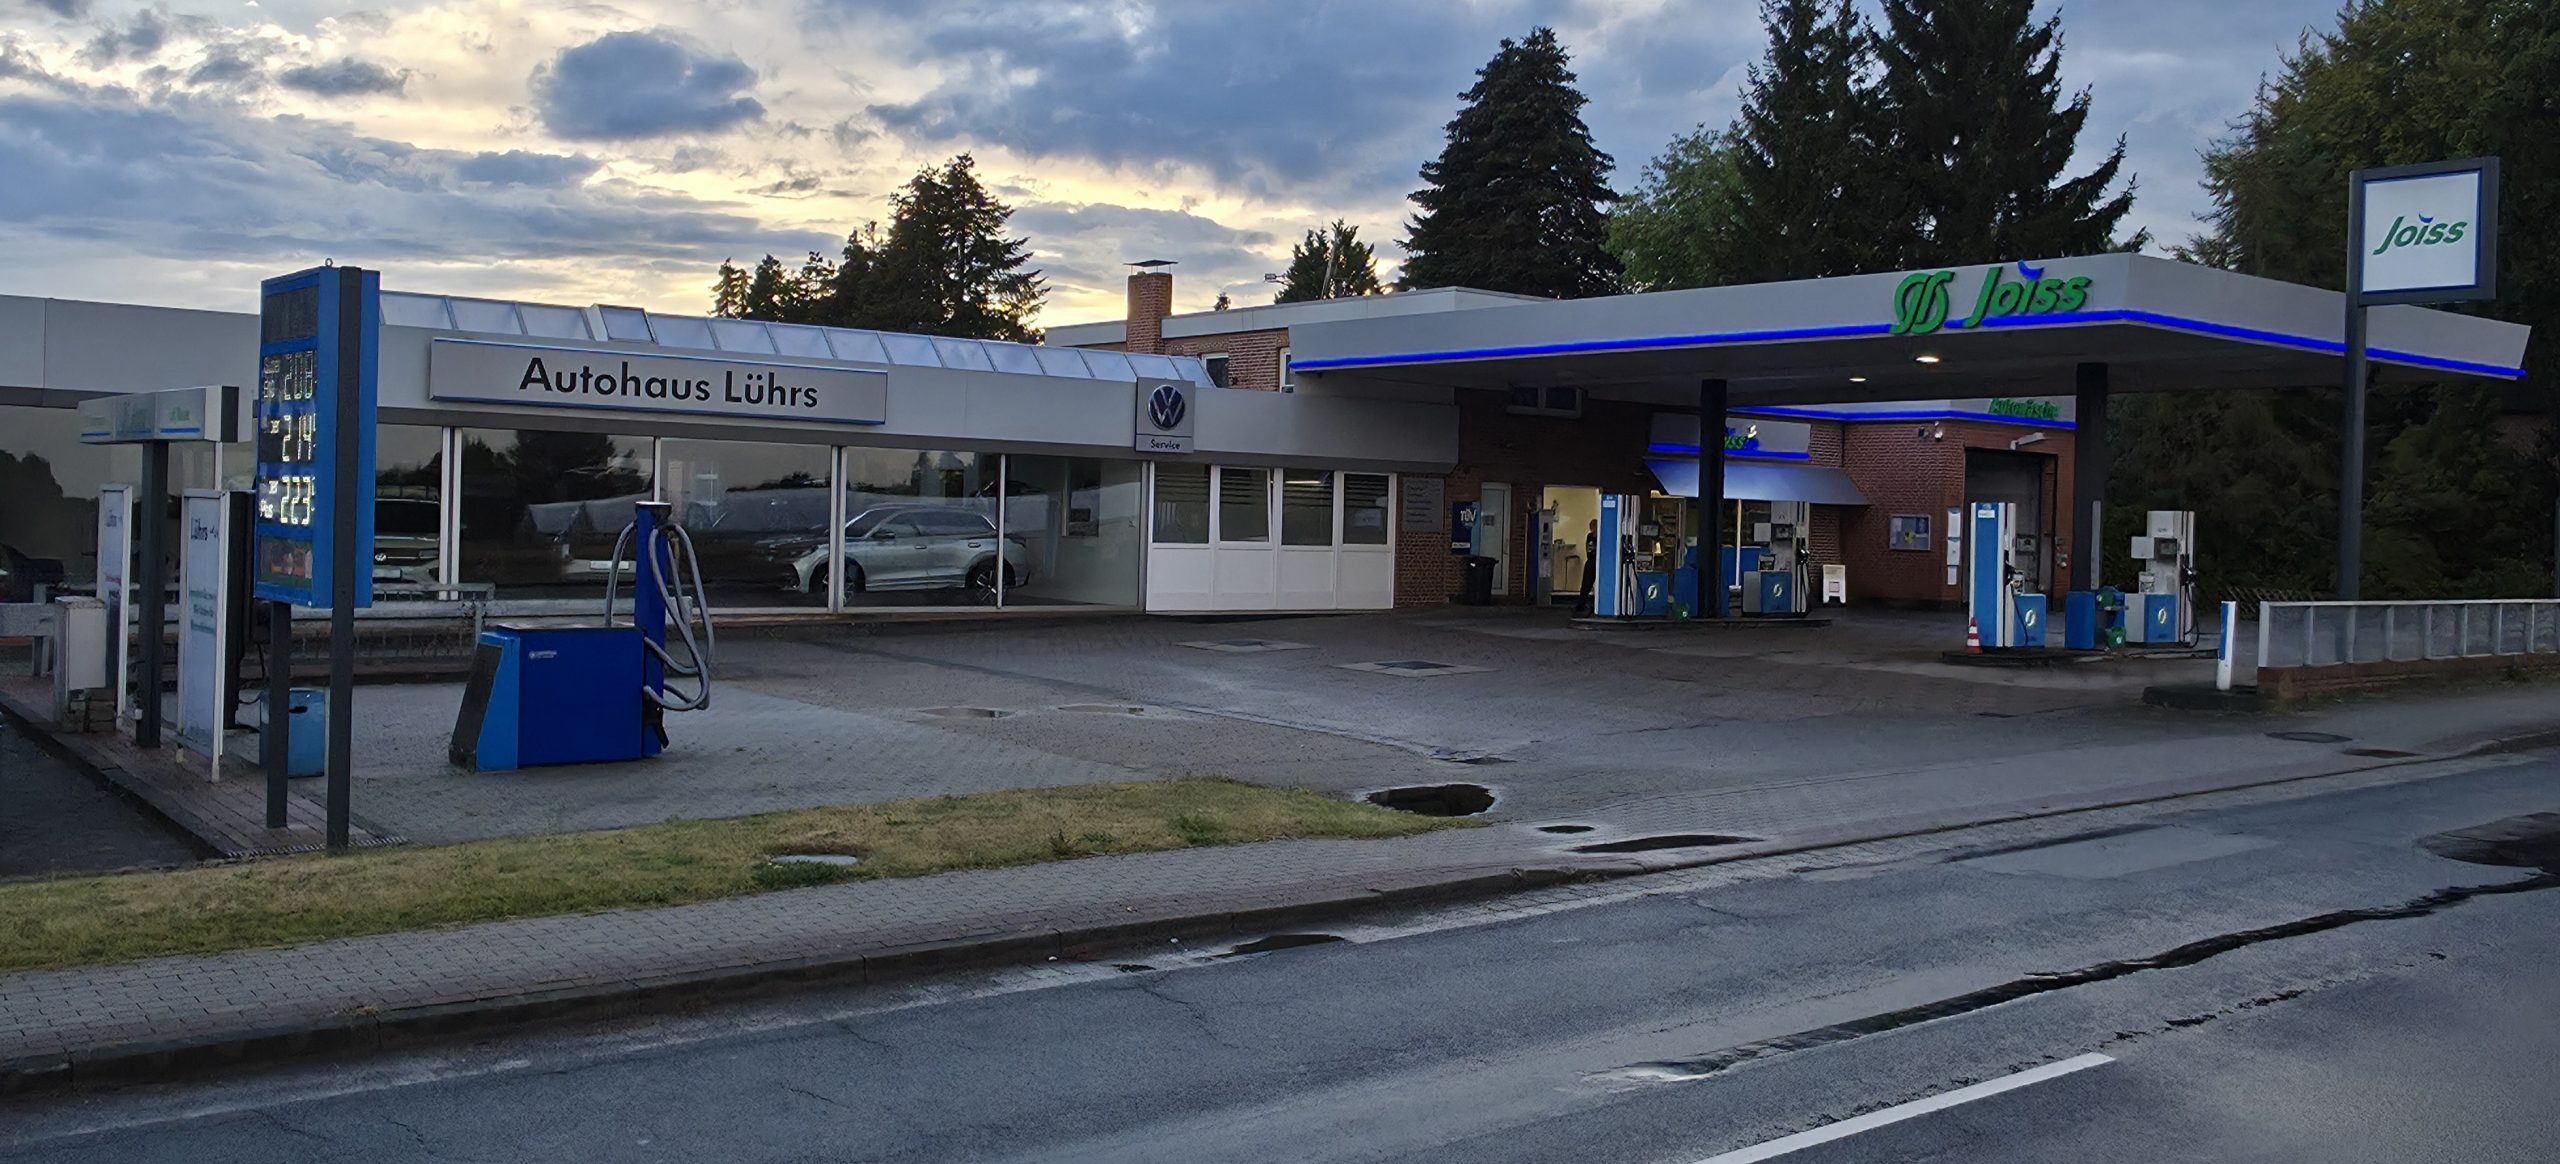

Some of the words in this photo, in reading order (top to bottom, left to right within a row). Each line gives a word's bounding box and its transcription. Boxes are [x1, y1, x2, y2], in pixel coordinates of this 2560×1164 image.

[2372, 212, 2468, 256] Joiss
[1963, 260, 2093, 329] Joiss
[519, 357, 712, 401] Autohaus
[725, 370, 818, 408] Lührs
[1150, 438, 1181, 450] Service
